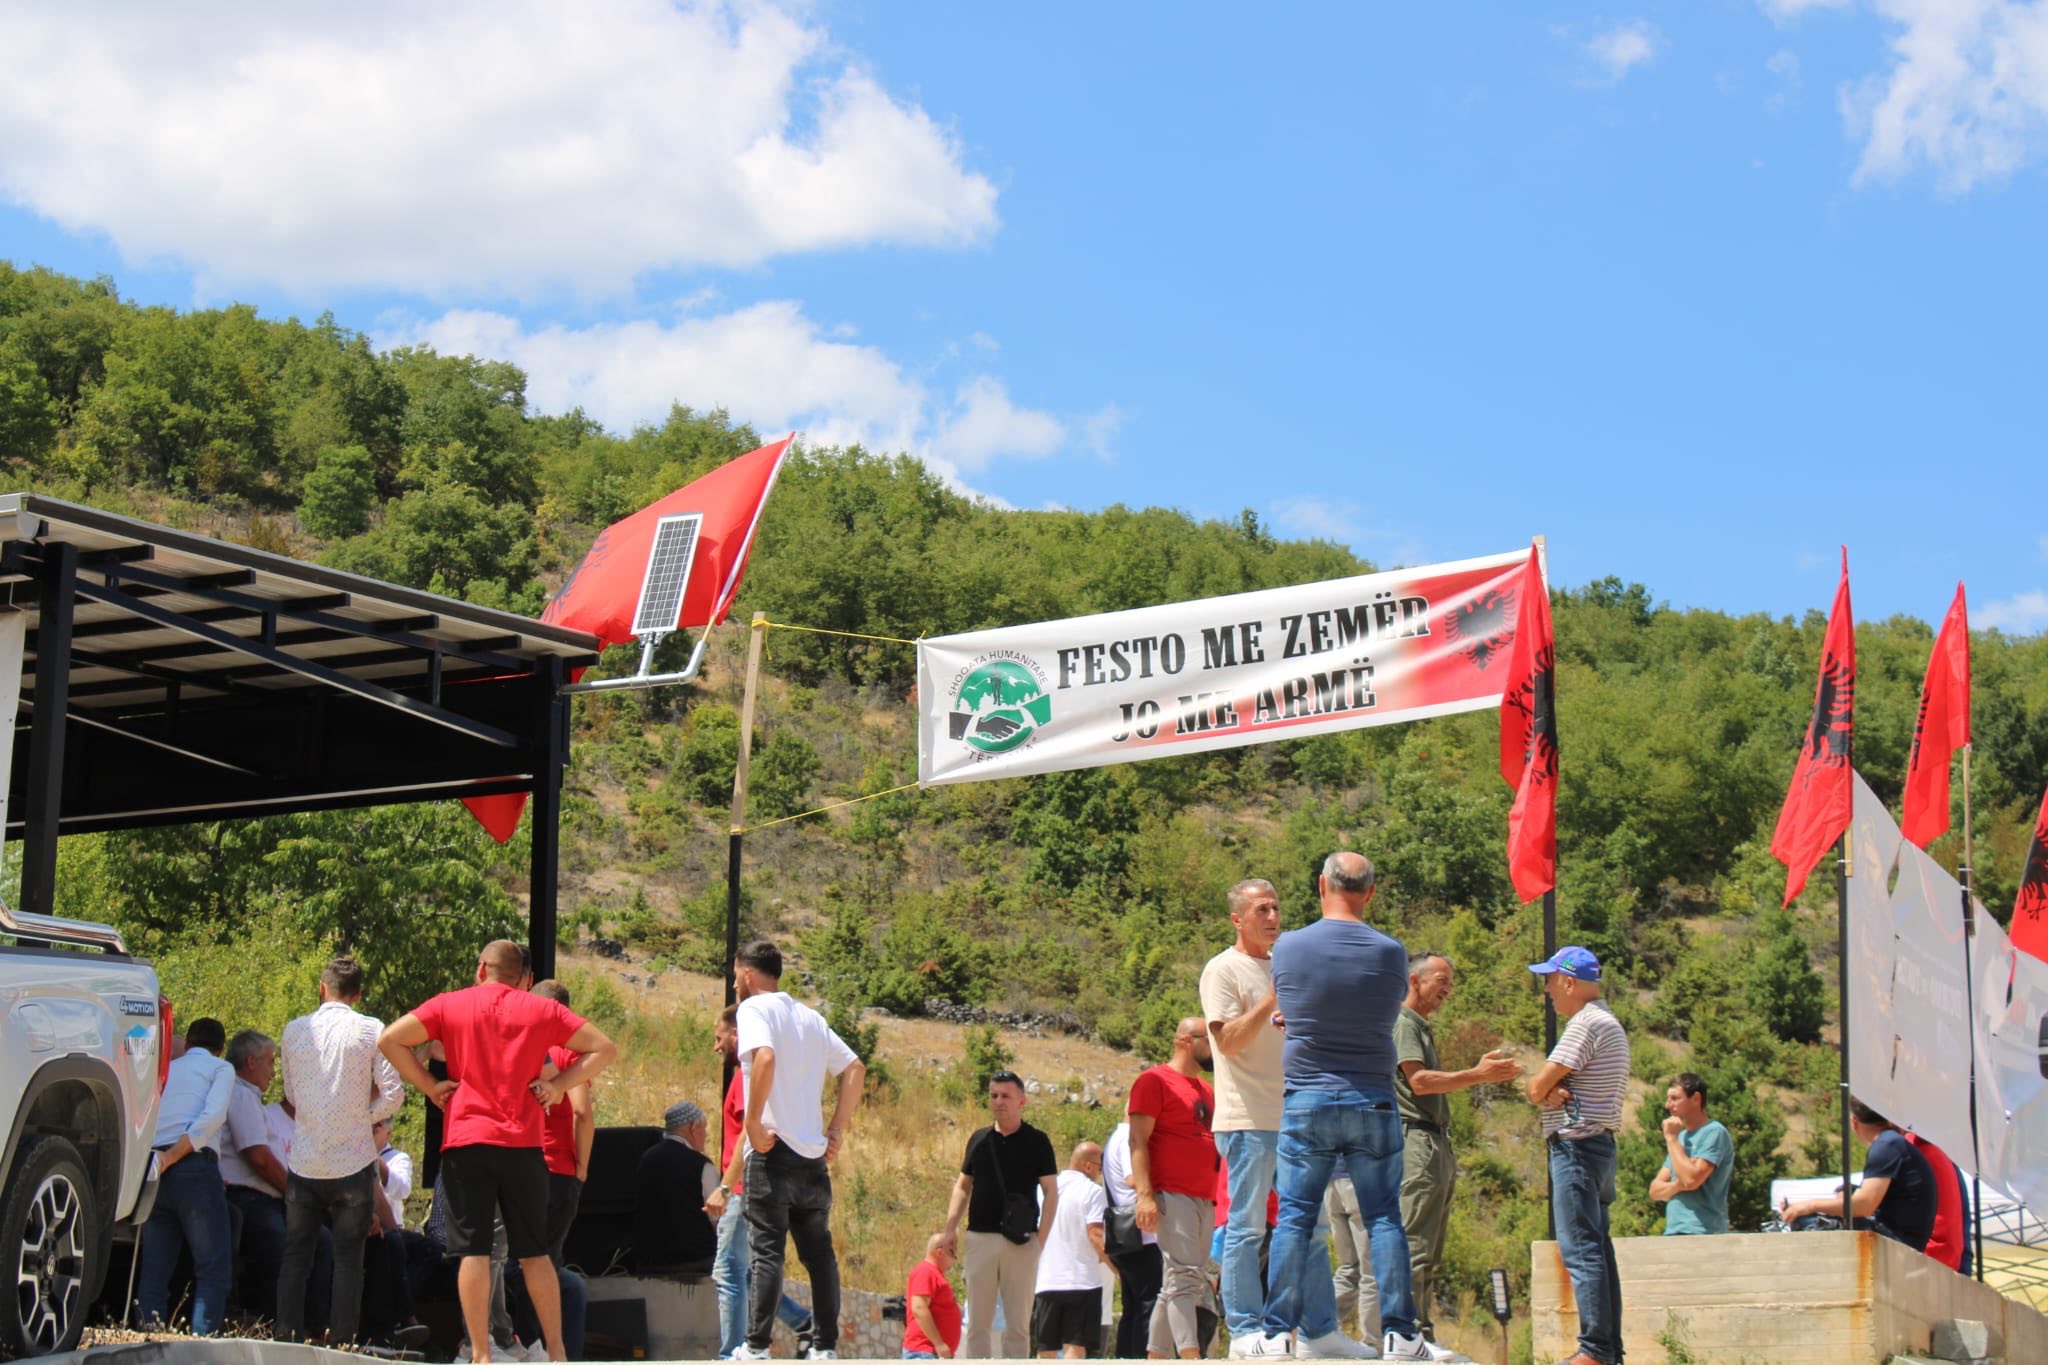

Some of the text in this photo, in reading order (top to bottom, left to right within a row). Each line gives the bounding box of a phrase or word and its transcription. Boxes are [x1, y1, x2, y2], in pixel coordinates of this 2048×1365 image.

[948, 649, 1048, 697] SHOQATA HUMANITARE
[1057, 592, 1430, 689] FESTO ME ZEMËR
[1112, 656, 1376, 742] JO ME ARMË
[120, 995, 154, 1015] 4MOTION
